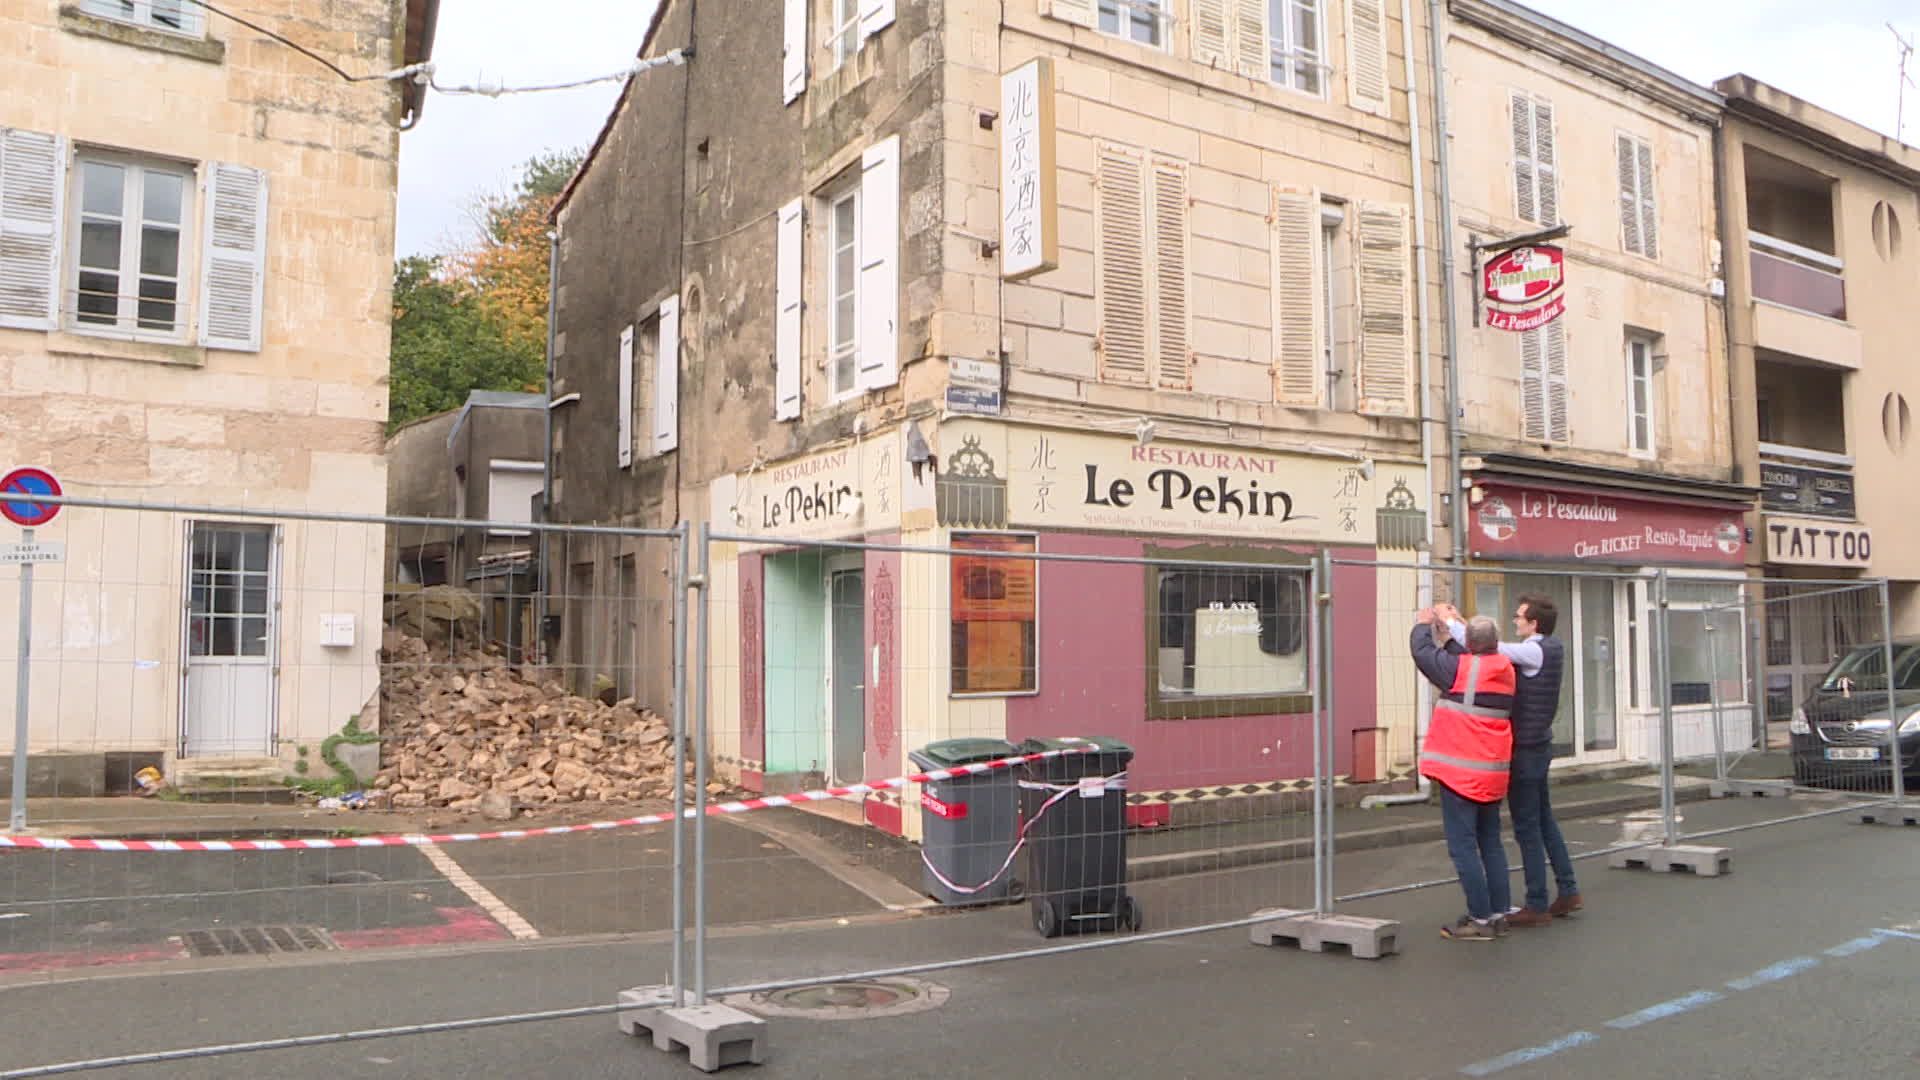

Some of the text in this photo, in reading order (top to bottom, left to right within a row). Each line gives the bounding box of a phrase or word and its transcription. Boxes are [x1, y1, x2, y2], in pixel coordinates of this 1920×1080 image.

[1005, 79, 1036, 257] 北京酒家
[1491, 303, 1559, 330] Le Pescadou
[773, 452, 848, 484] RESTAURANT
[1131, 445, 1280, 474] RESTAURANT
[1084, 463, 1320, 523] Le Pekin
[1520, 492, 1543, 519] Le
[1546, 495, 1618, 523] Pescadou
[762, 495, 782, 529] Le
[1574, 535, 1643, 558] Chez RICKET
[1645, 525, 1714, 552] Resto-Rapide
[1769, 525, 1870, 561] TATTOO
[1208, 601, 1258, 613] PLATS
